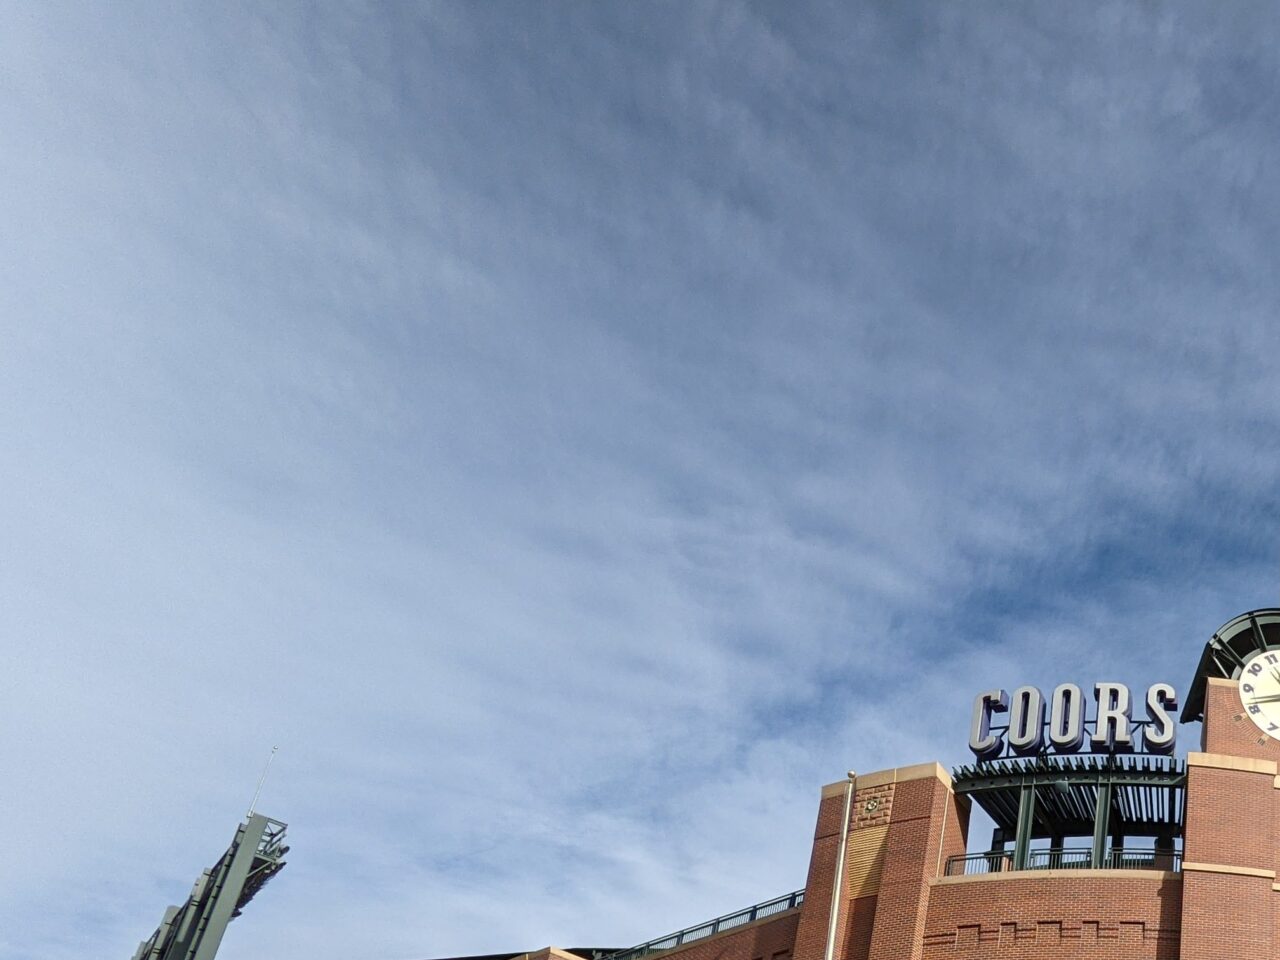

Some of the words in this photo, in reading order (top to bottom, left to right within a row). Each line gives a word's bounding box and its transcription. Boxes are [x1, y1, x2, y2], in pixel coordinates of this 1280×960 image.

[1264, 654, 1278, 665] 11
[1247, 663, 1262, 676] 10
[1243, 684, 1254, 693] 9
[1248, 705, 1260, 715] 8
[968, 682, 1178, 757] COORS
[1267, 722, 1279, 731] 7
